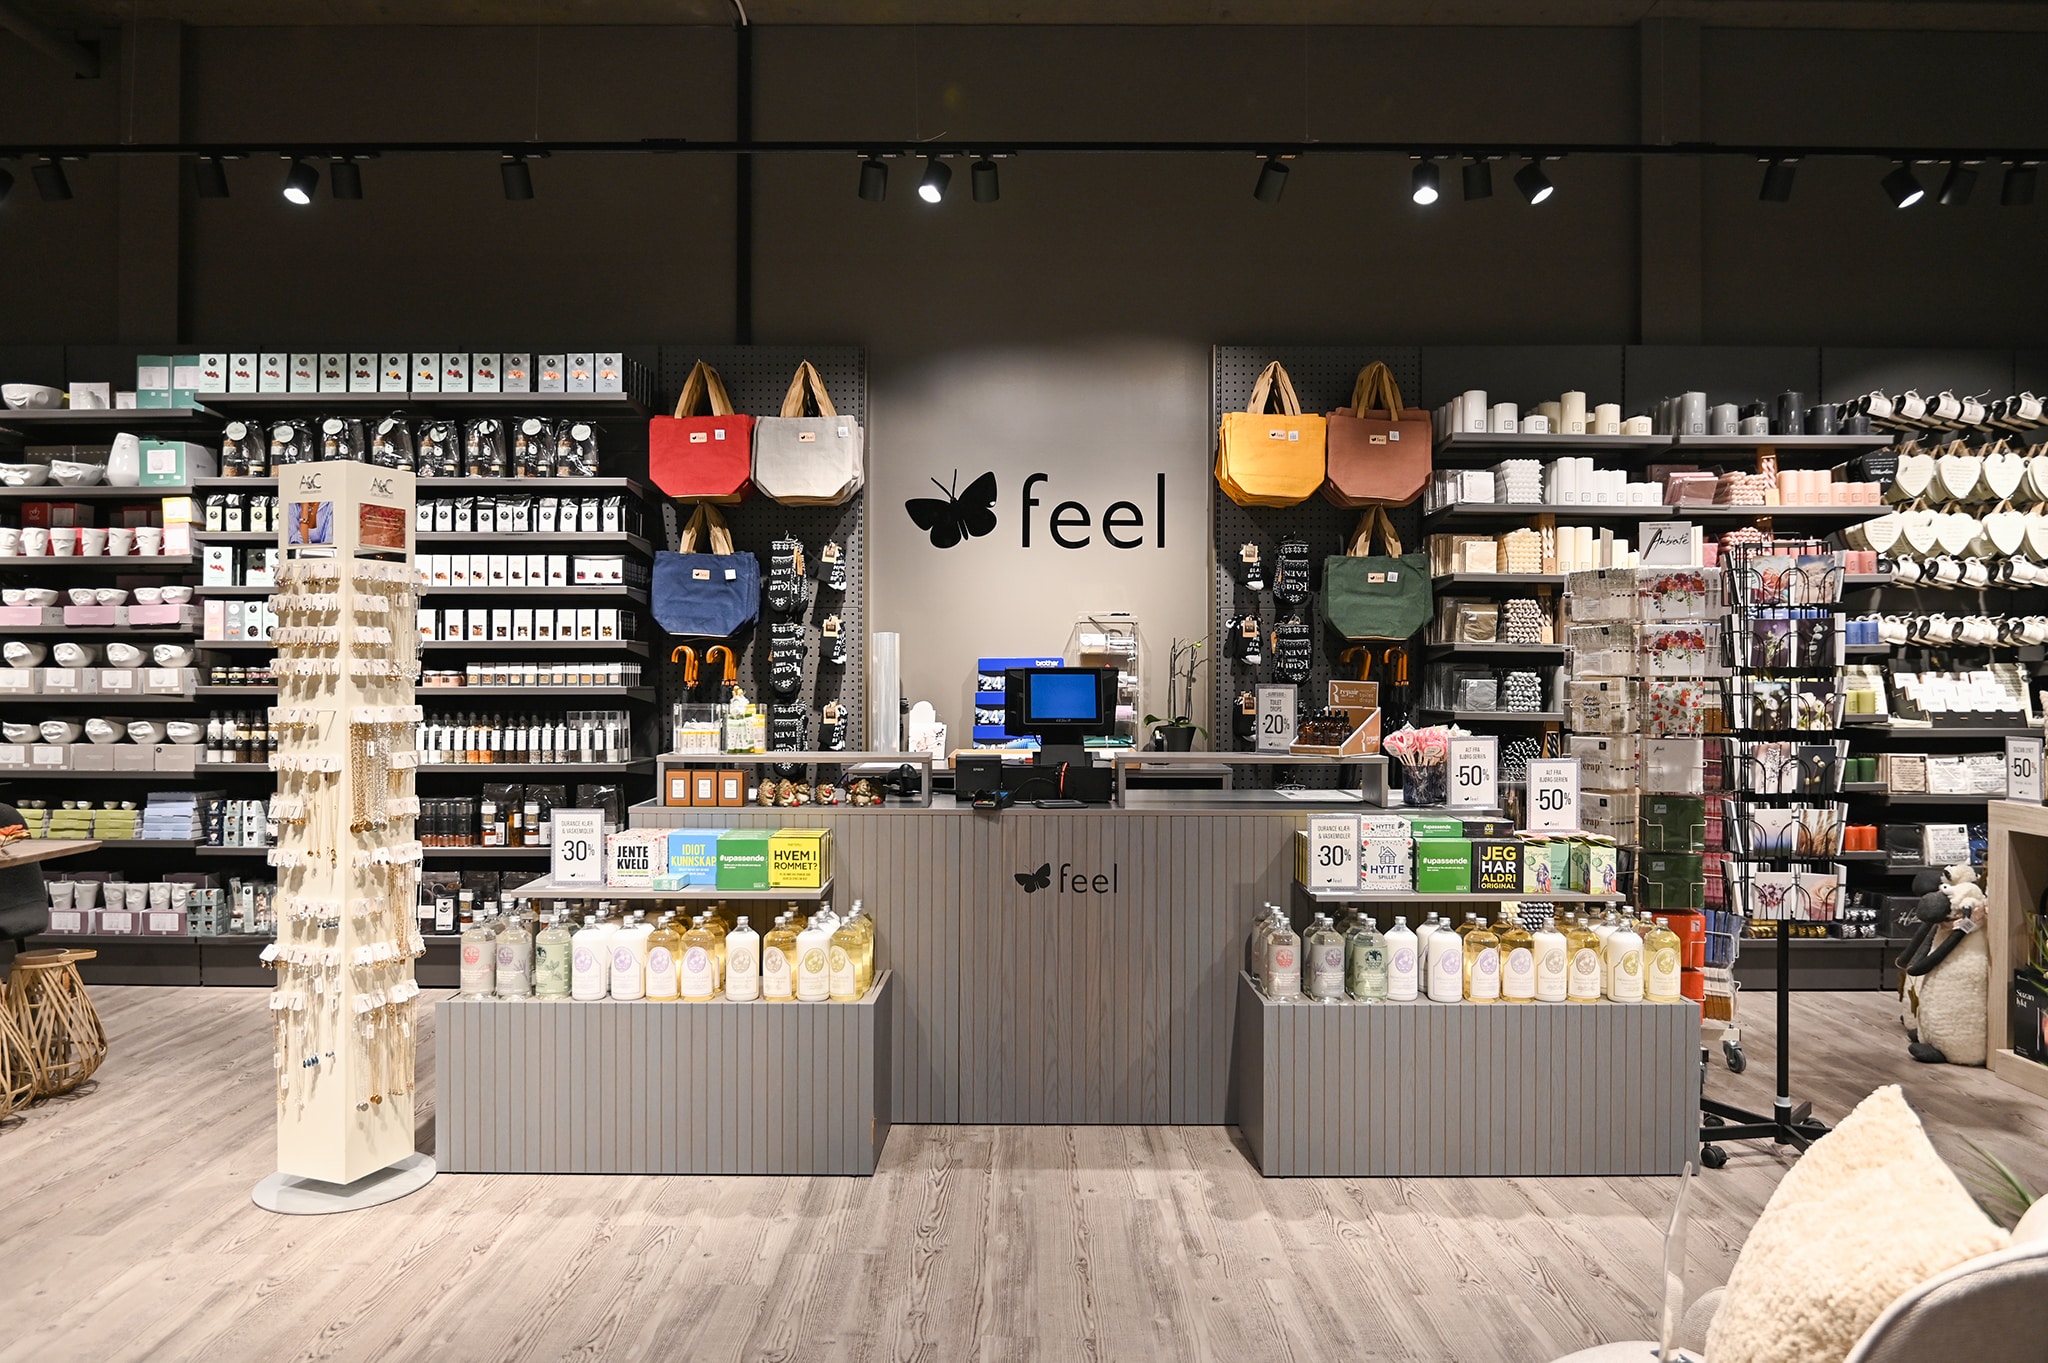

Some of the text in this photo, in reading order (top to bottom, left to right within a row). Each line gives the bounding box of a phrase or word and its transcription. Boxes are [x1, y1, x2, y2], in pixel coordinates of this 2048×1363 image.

[1022, 472, 1165, 549] feel
[1262, 714, 1290, 734] -20%
[2011, 758, 2037, 778] -50%
[1455, 765, 1490, 786] -50%
[1535, 788, 1572, 811] -50%
[561, 840, 596, 861] -30%
[617, 846, 649, 858] JENTE
[682, 843, 706, 855] IDIOT
[1482, 846, 1517, 860] JEG
[671, 856, 717, 867] KUNNSKAP
[719, 854, 765, 863] #upassende
[774, 850, 816, 861] HVEM I
[1317, 845, 1352, 867] -30%
[1423, 857, 1468, 865] #upassende
[617, 859, 649, 870] KVELD
[774, 862, 818, 871] ROMMET?
[1370, 865, 1405, 874] HYTTE
[1481, 861, 1516, 873] HAR
[1060, 863, 1117, 893] feel
[1481, 874, 1516, 883] ALDRI
[2016, 989, 2035, 1001] Suzan
